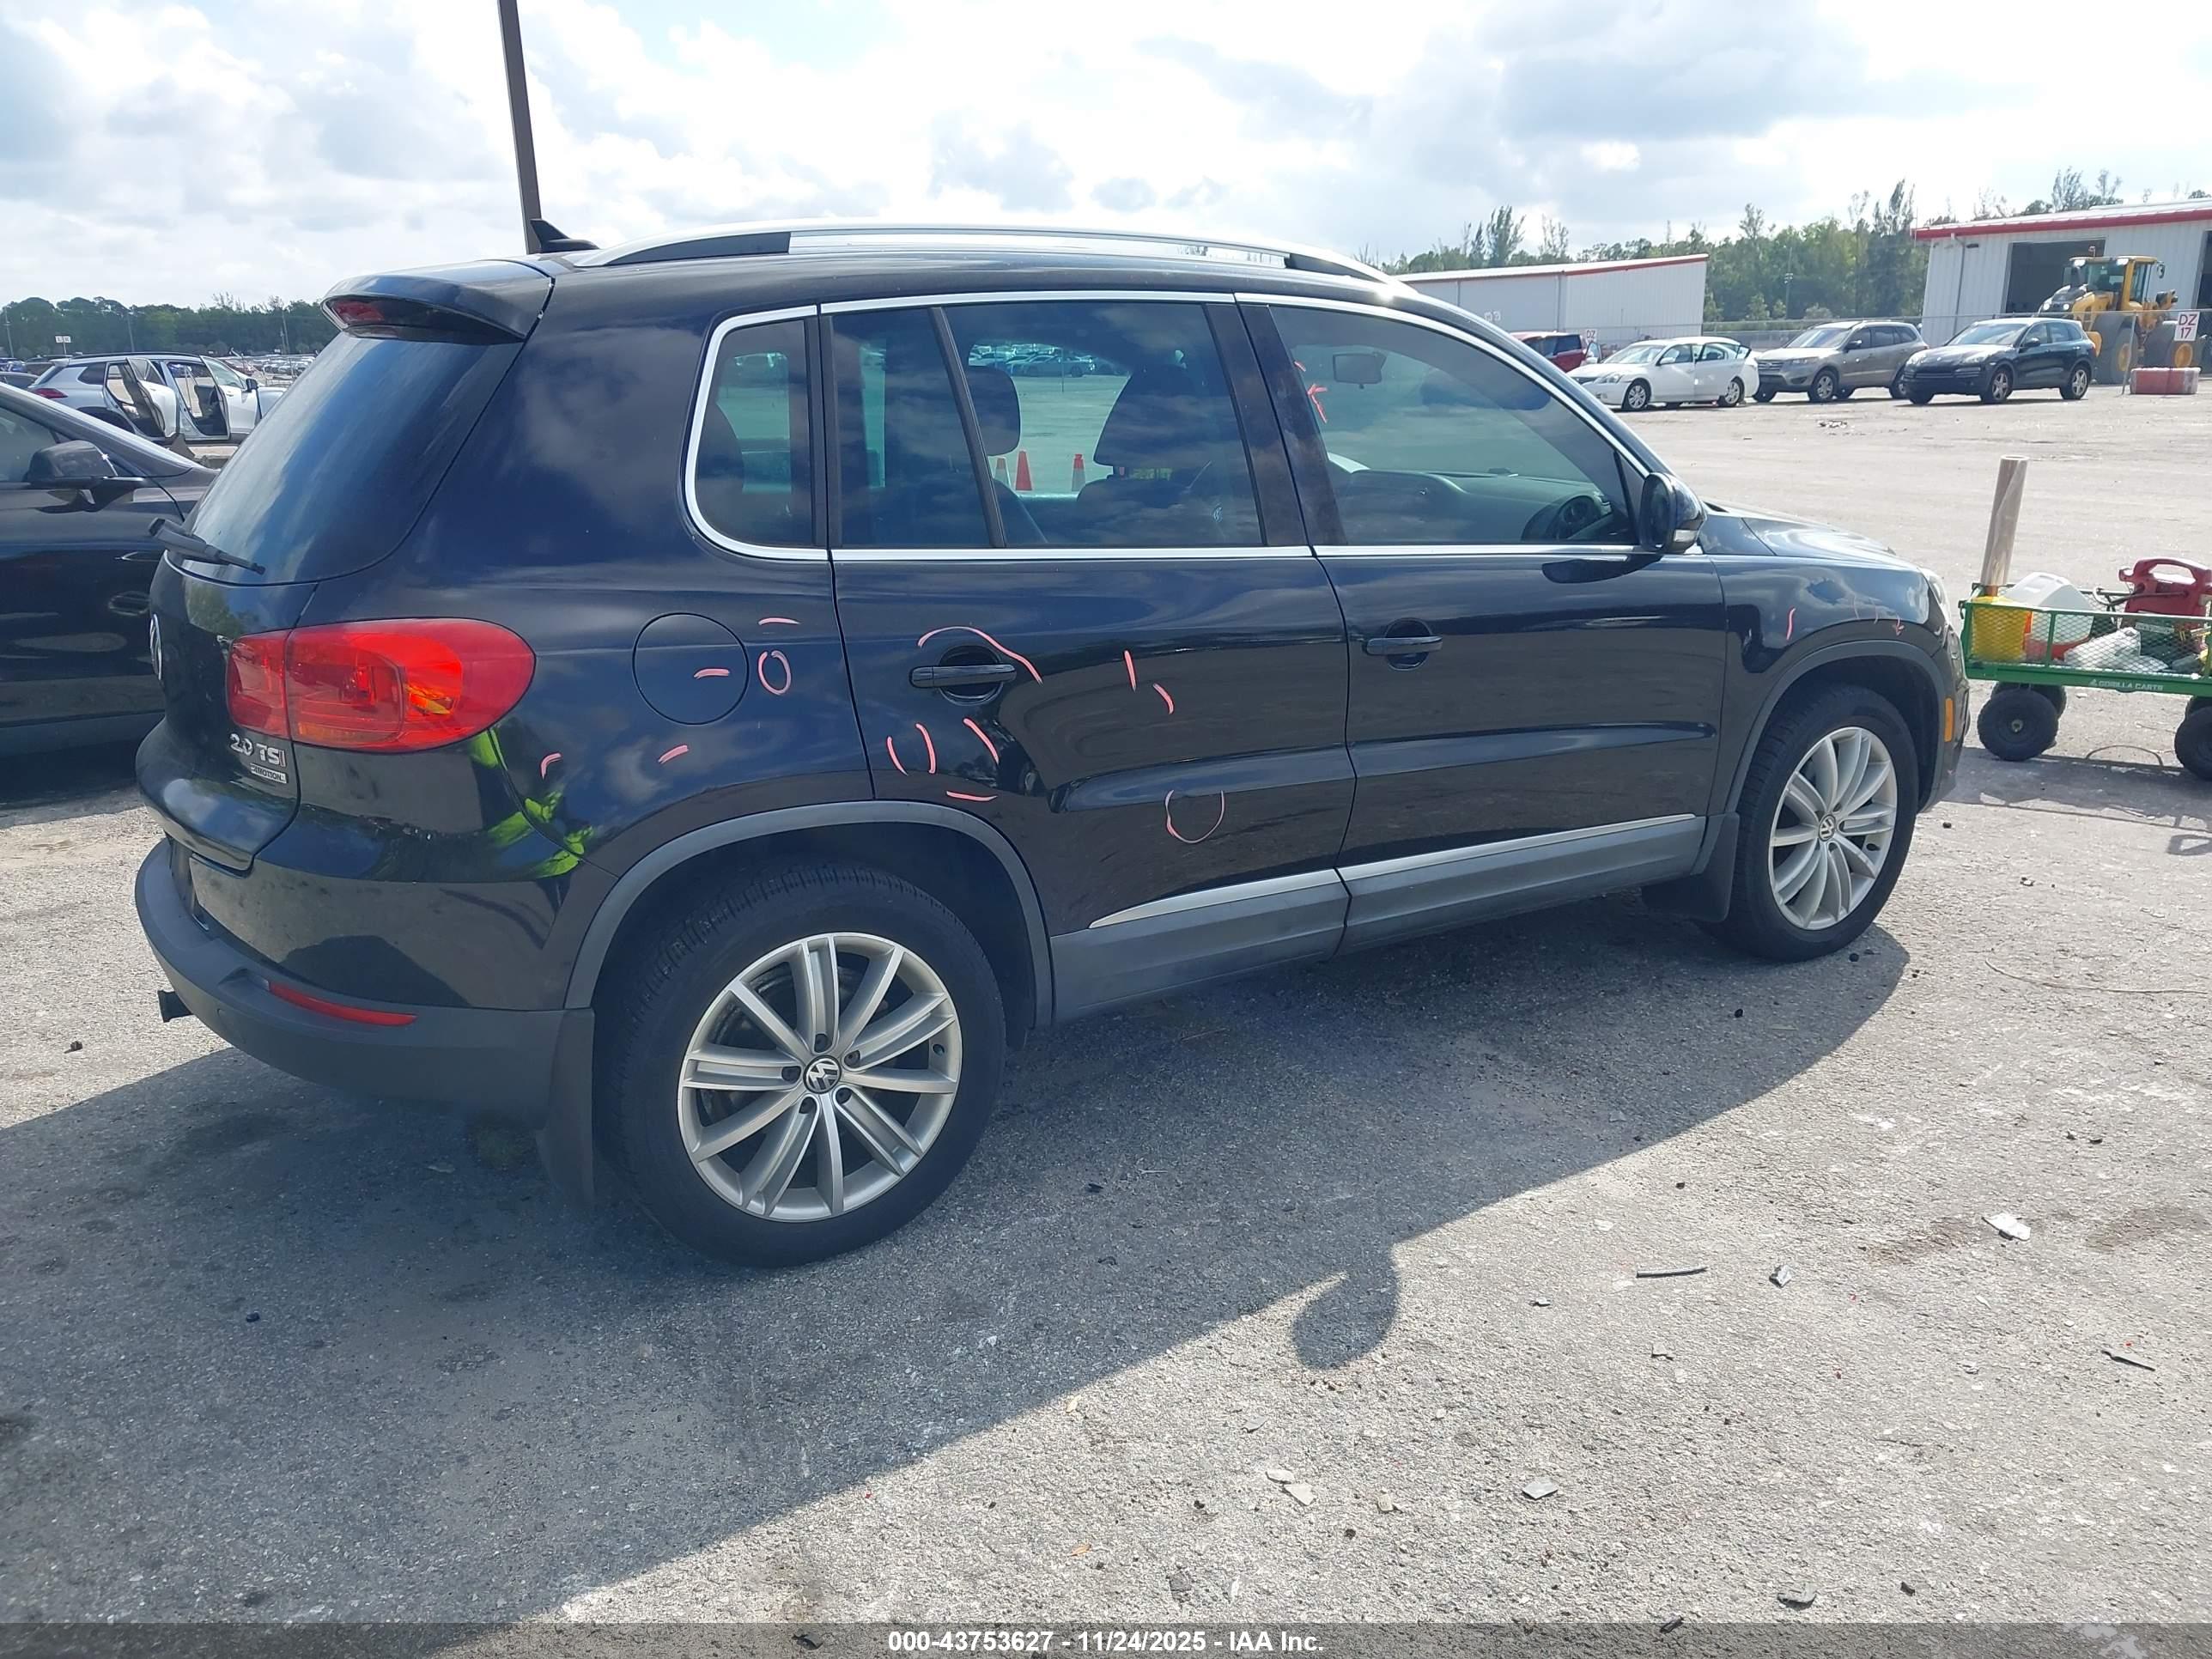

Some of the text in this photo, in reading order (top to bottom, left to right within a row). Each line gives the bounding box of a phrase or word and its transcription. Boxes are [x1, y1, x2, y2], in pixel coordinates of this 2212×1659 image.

[2179, 313, 2197, 325] DZ
[2181, 327, 2192, 338] 17
[2099, 680, 2164, 691] GORILLA CARTS
[256, 742, 287, 768] TSI
